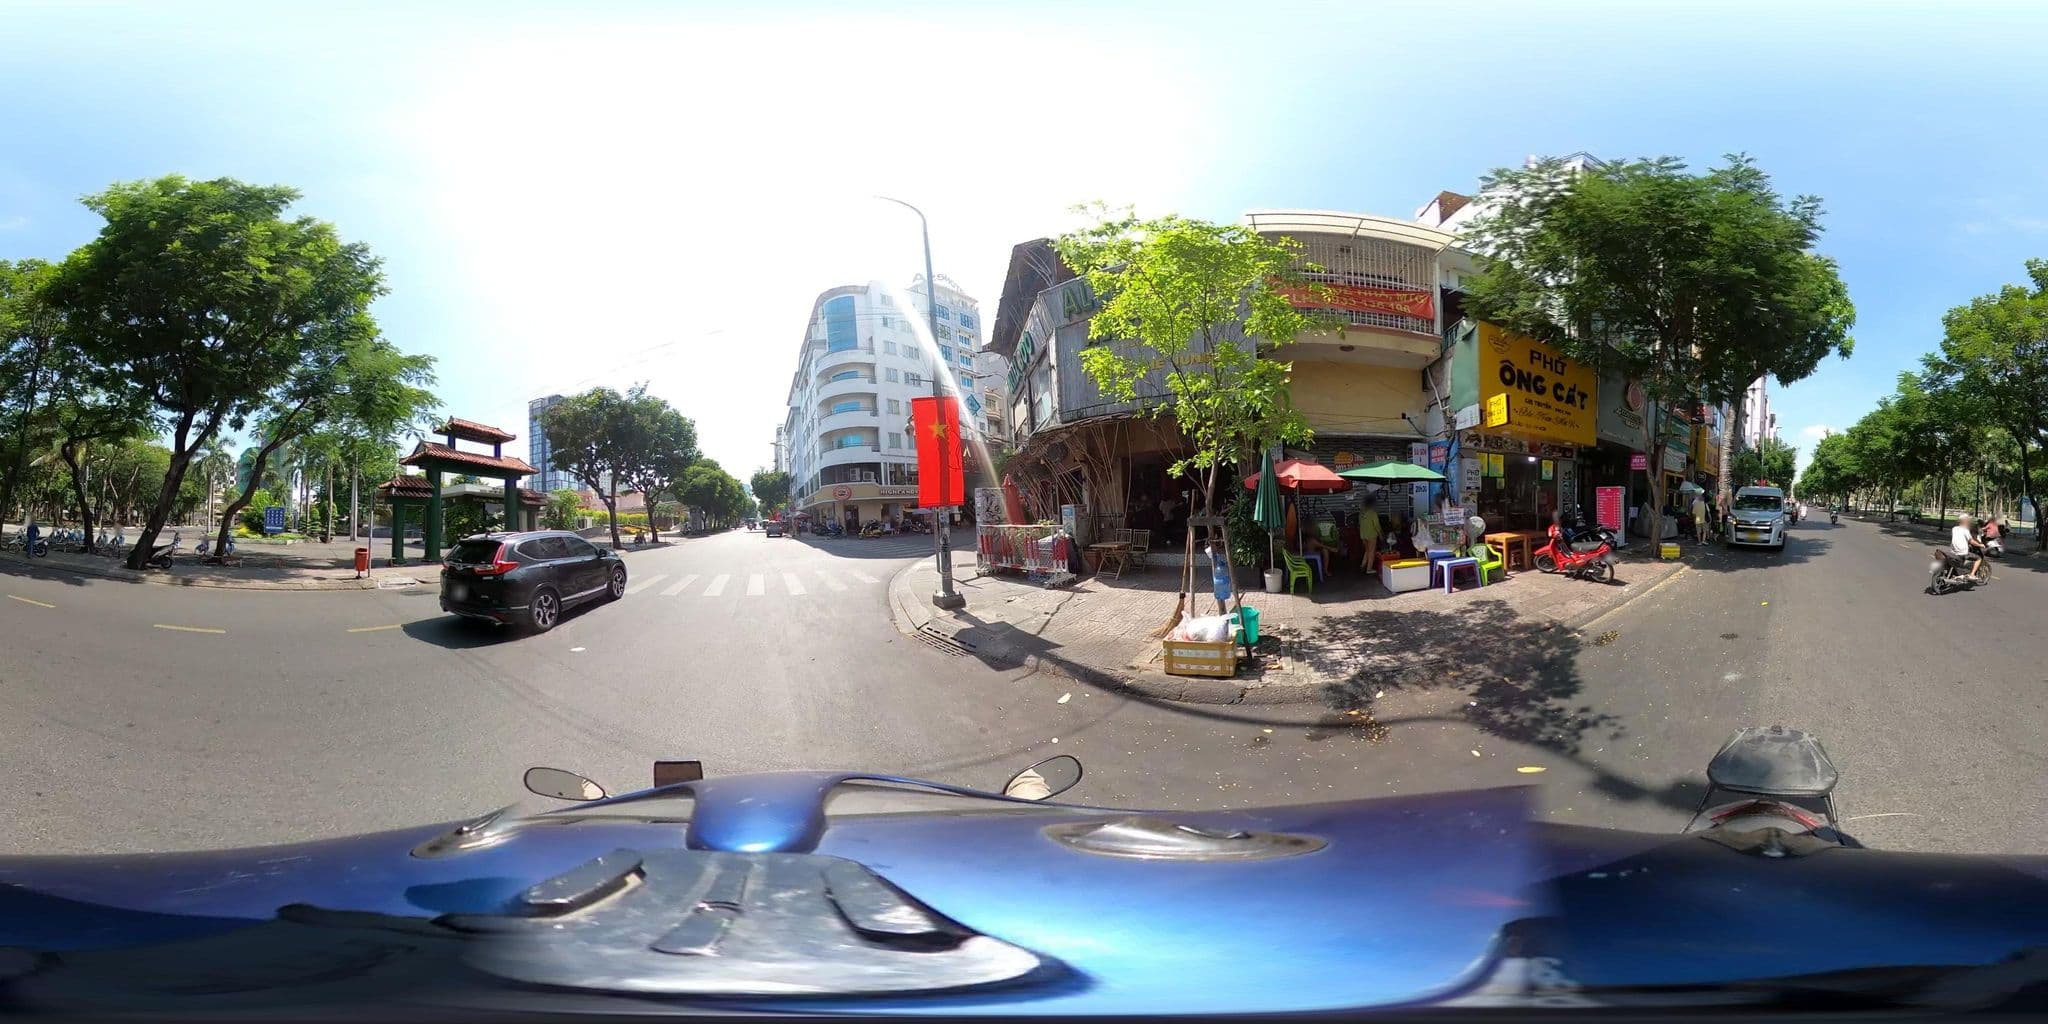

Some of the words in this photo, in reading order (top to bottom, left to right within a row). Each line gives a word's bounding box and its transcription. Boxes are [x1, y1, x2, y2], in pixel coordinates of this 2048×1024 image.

[1530, 349, 1567, 376] PHỞ
[1499, 360, 1546, 396] ÔNG
[1553, 382, 1588, 410] CÁT
